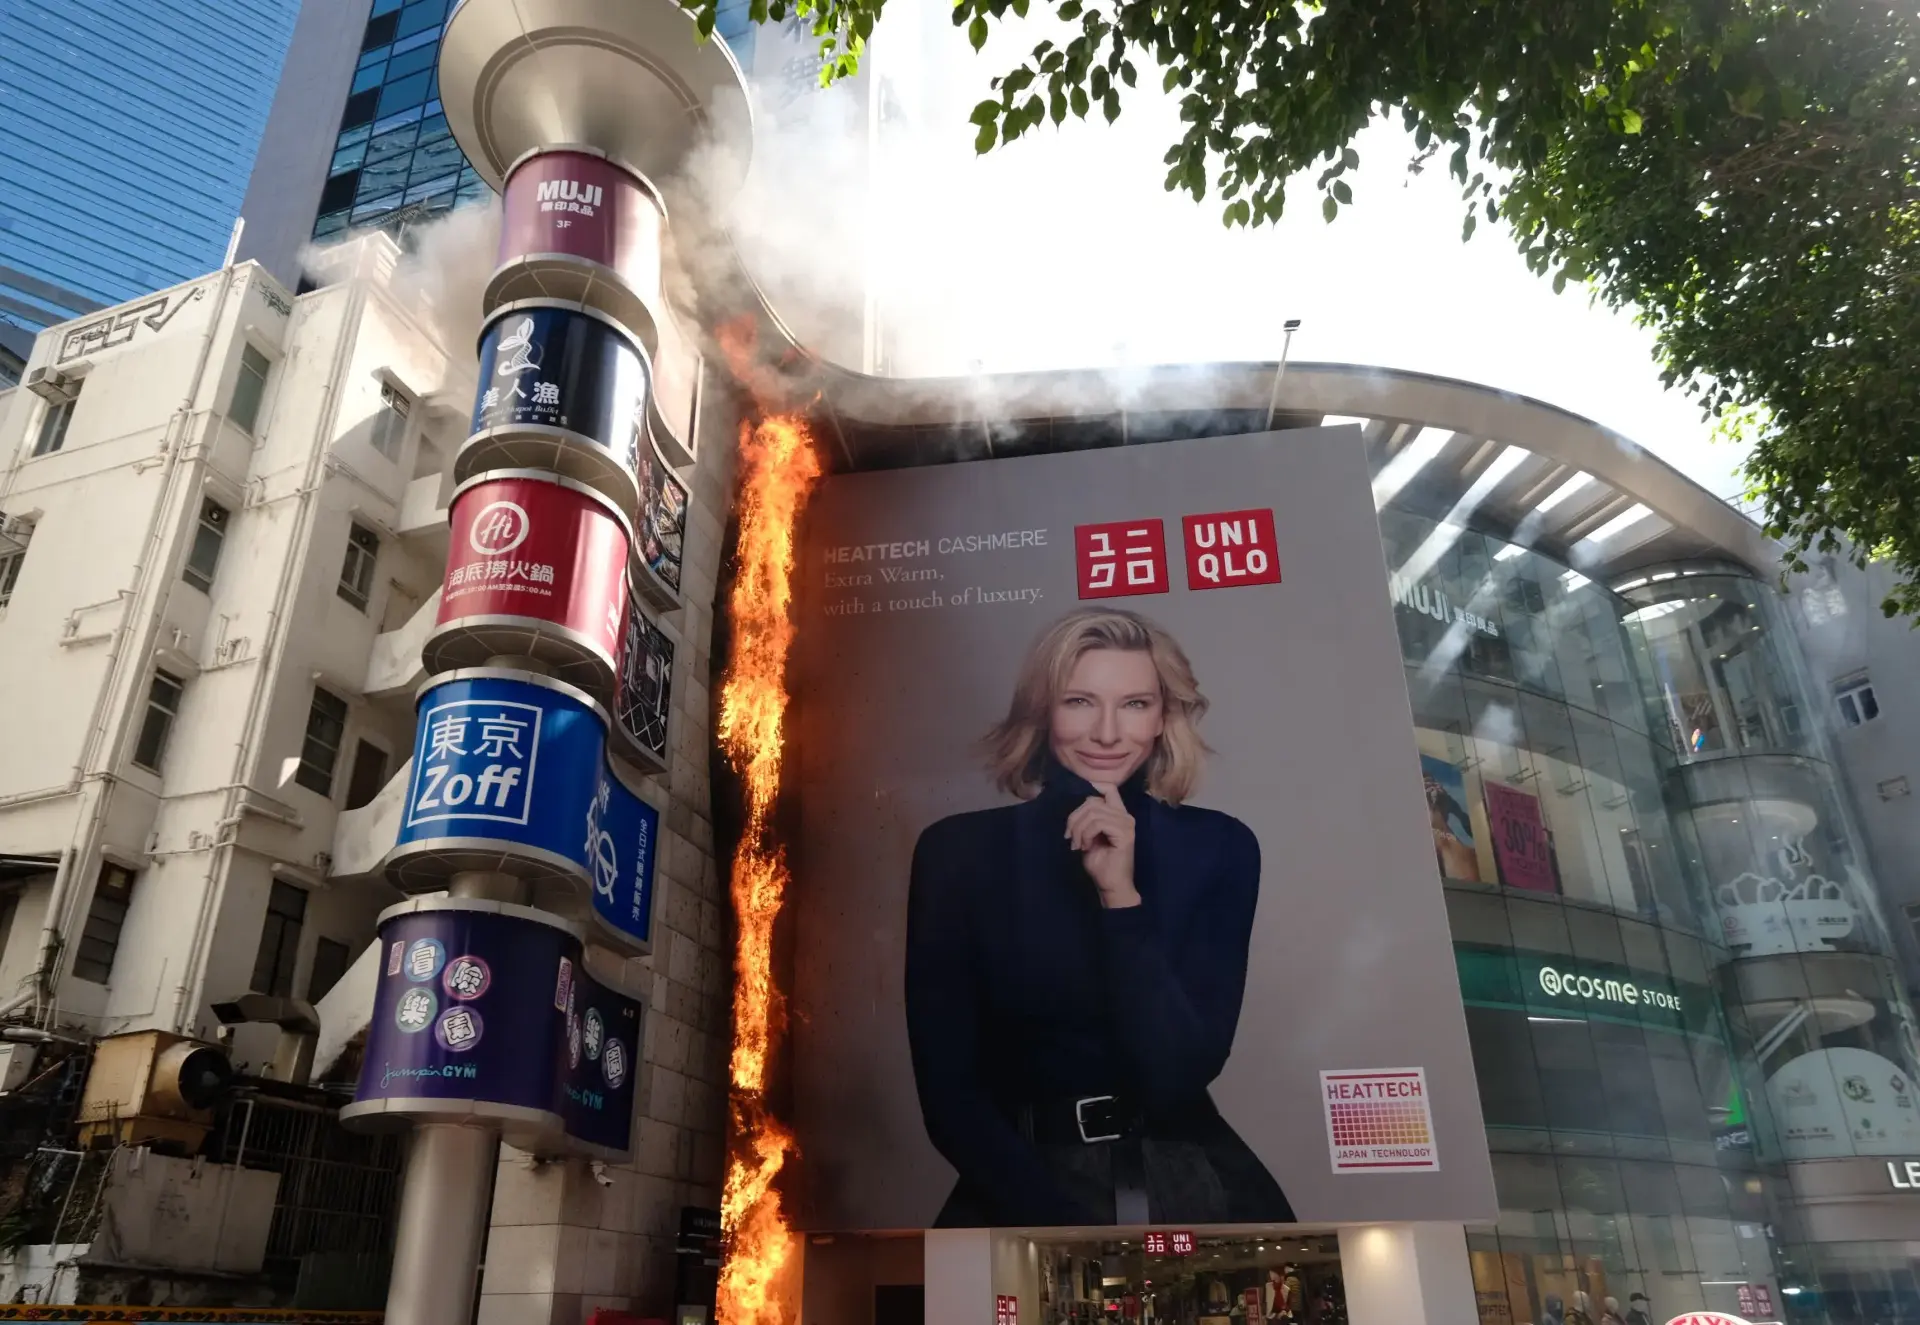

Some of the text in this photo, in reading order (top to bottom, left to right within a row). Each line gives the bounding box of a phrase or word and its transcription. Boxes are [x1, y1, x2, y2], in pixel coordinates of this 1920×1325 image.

[537, 180, 602, 207] MUJI
[556, 220, 572, 229] 3F
[823, 529, 1048, 564] HEATTECH CASHMERE
[1194, 519, 1259, 548] UNI
[448, 560, 554, 590] 海底撈火鍋
[824, 566, 945, 588] Extra Warm,
[1198, 549, 1268, 583] QLO
[823, 586, 1044, 616] with a touch of luxury.
[1389, 574, 1450, 624] MUJI
[425, 713, 528, 763] 東京
[416, 764, 522, 812] Zoff
[1539, 966, 1682, 1011] @cosme STORE
[443, 1065, 477, 1079] GYM
[1327, 1081, 1422, 1099] HEATTECH
[1336, 1148, 1431, 1159] JAPAN TECHNOLOGY
[1173, 1234, 1190, 1243] UNI
[1174, 1243, 1192, 1253] QLO
